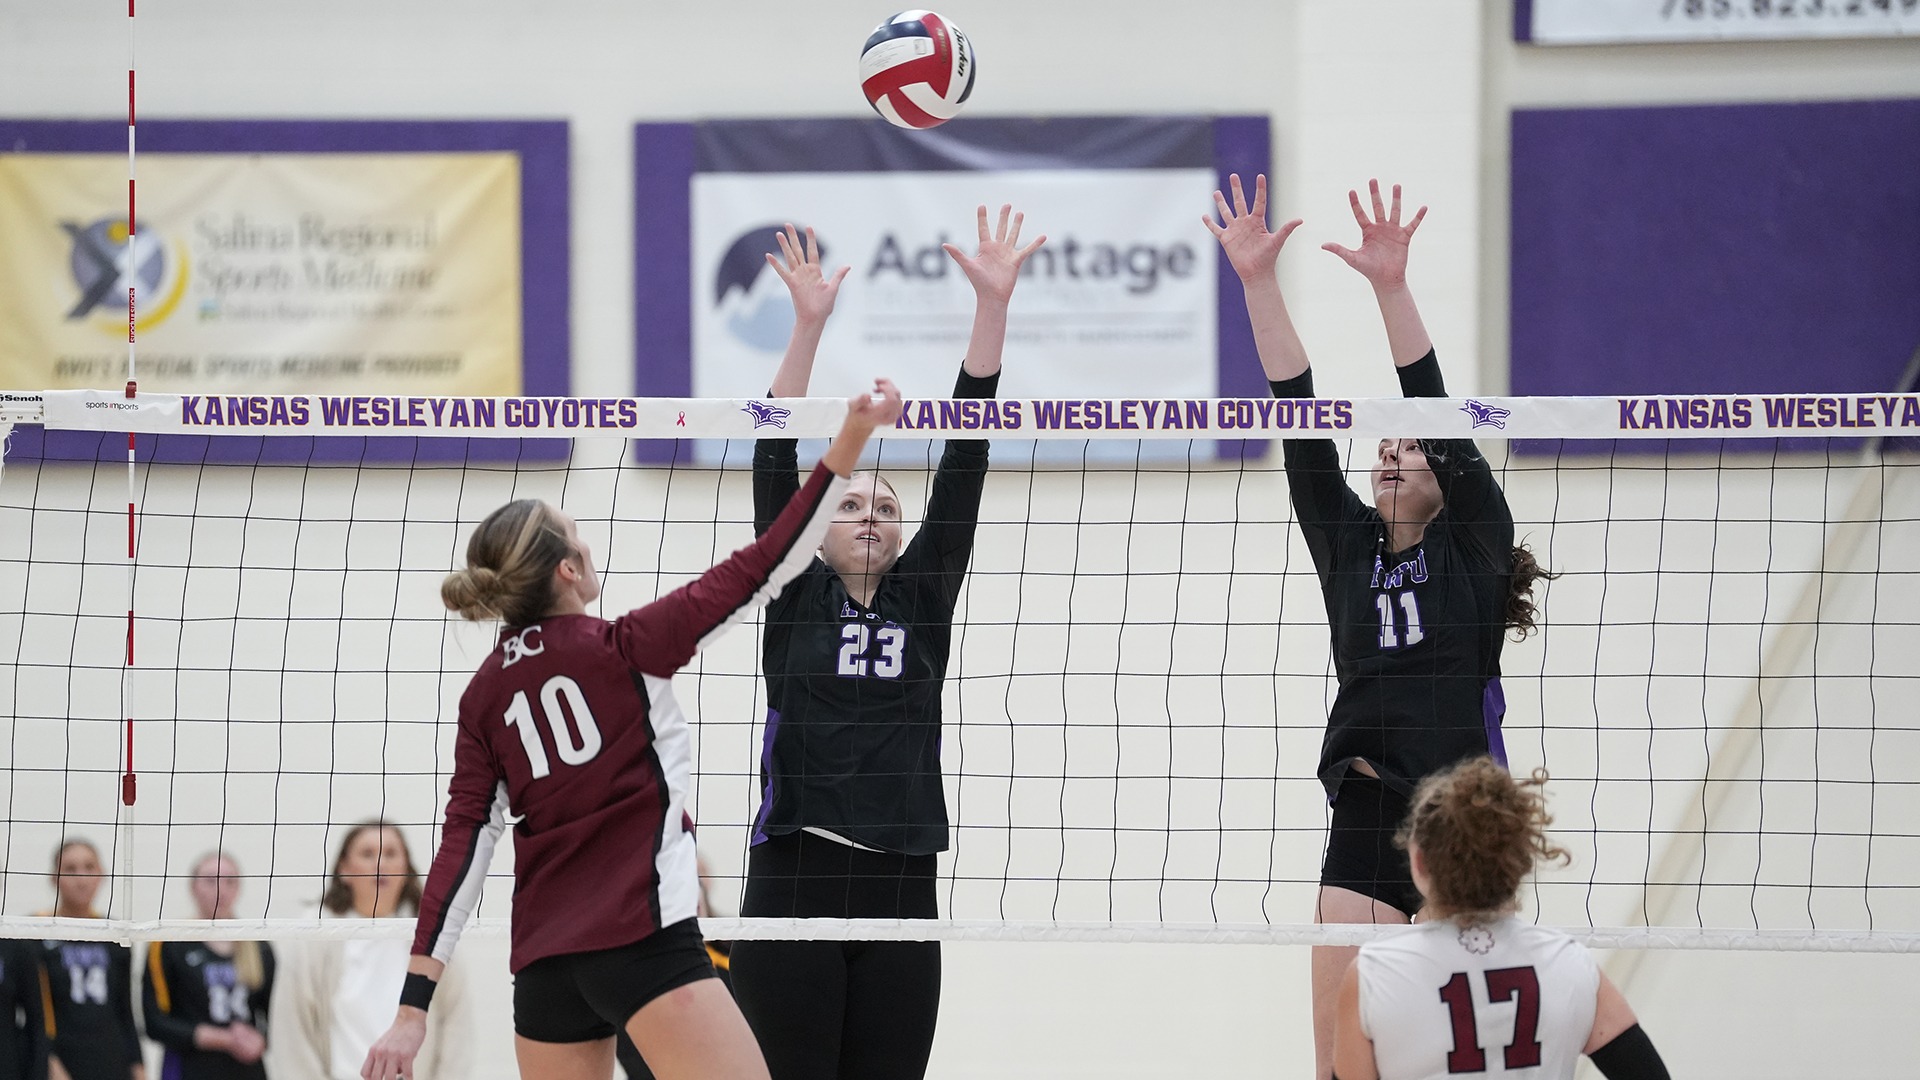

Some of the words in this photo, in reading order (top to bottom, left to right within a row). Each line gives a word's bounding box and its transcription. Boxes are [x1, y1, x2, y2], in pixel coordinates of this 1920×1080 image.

[866, 231, 1196, 294] Adntage
[5, 394, 43, 402] Senoh
[181, 396, 310, 426] KANSAS
[319, 397, 496, 428] WESLEYAN
[504, 398, 638, 428] COYOTES
[895, 400, 1022, 430] KANSAS
[1032, 400, 1209, 430] WESLEYAN
[1217, 399, 1353, 429] COYOTES
[1618, 399, 1752, 430] KANSAS
[1375, 589, 1425, 650] 11
[502, 625, 545, 669] BC
[836, 621, 907, 679] 23
[503, 674, 603, 780] 10
[1438, 965, 1542, 1074] 17
